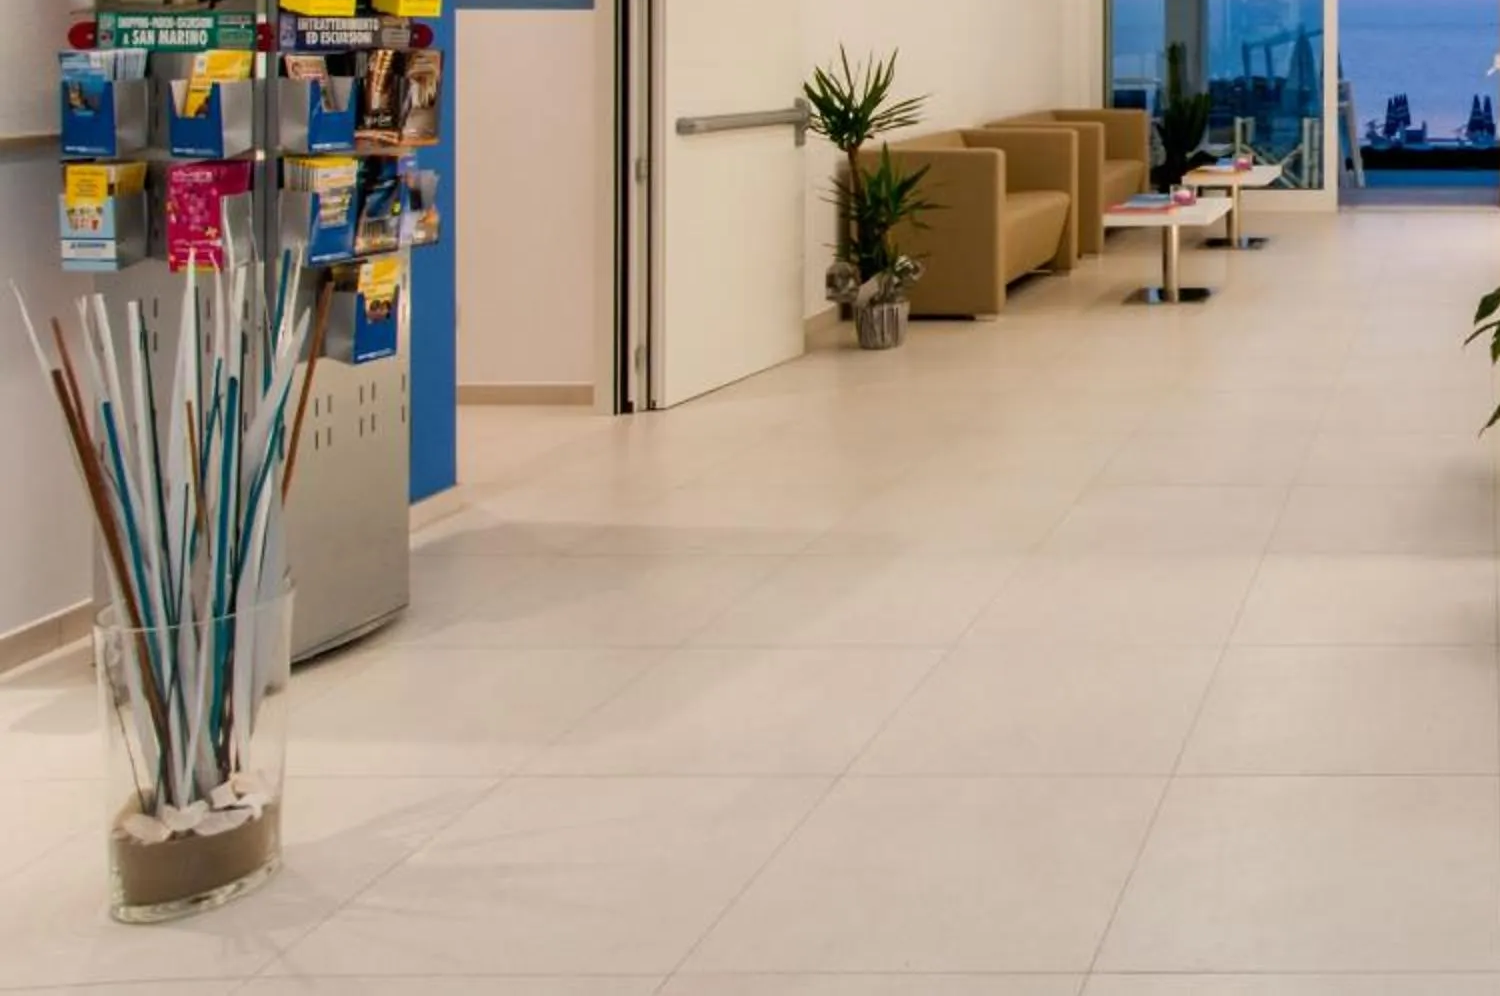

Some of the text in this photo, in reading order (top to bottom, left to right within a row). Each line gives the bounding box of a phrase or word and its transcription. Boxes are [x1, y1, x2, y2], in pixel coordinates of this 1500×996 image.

[132, 29, 155, 45] SAN
[158, 29, 209, 46] MARINO
[305, 31, 319, 45] ED
